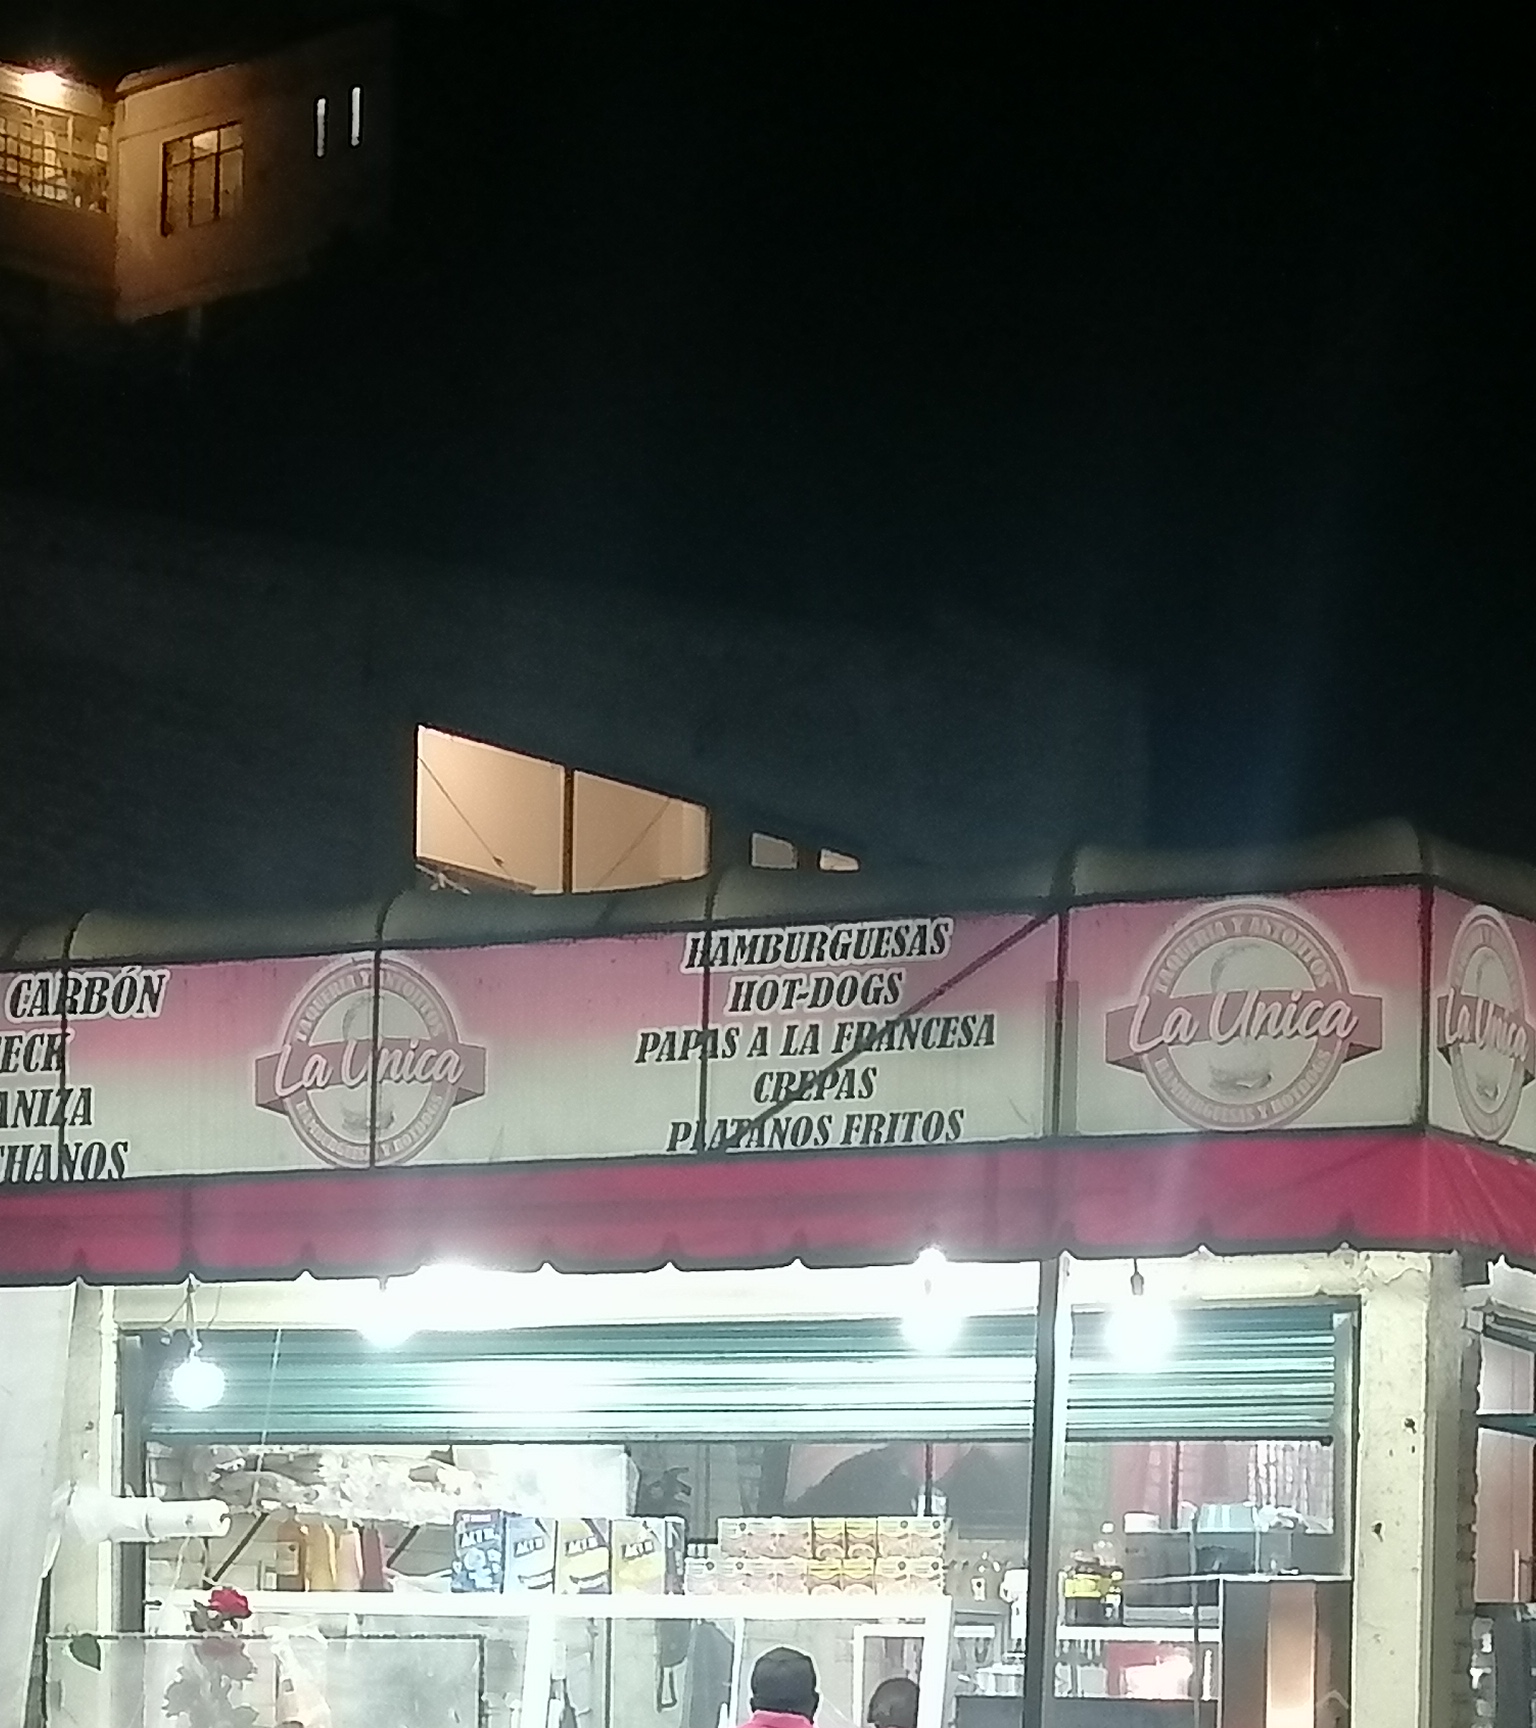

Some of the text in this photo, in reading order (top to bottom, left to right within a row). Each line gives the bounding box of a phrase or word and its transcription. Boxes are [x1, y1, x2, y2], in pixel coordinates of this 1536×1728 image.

[685, 921, 951, 970] HAMBURGUESAS
[9, 966, 166, 1018] CARBÓN
[728, 972, 903, 1014] HOT-DOGS
[1445, 987, 1472, 1045] La
[635, 1013, 996, 1065] PAPAS A LA FRANCESA
[1128, 994, 1198, 1055] La
[274, 1043, 333, 1097] La
[753, 1066, 878, 1105] CREPAS
[840, 1109, 964, 1147] FRITOS
